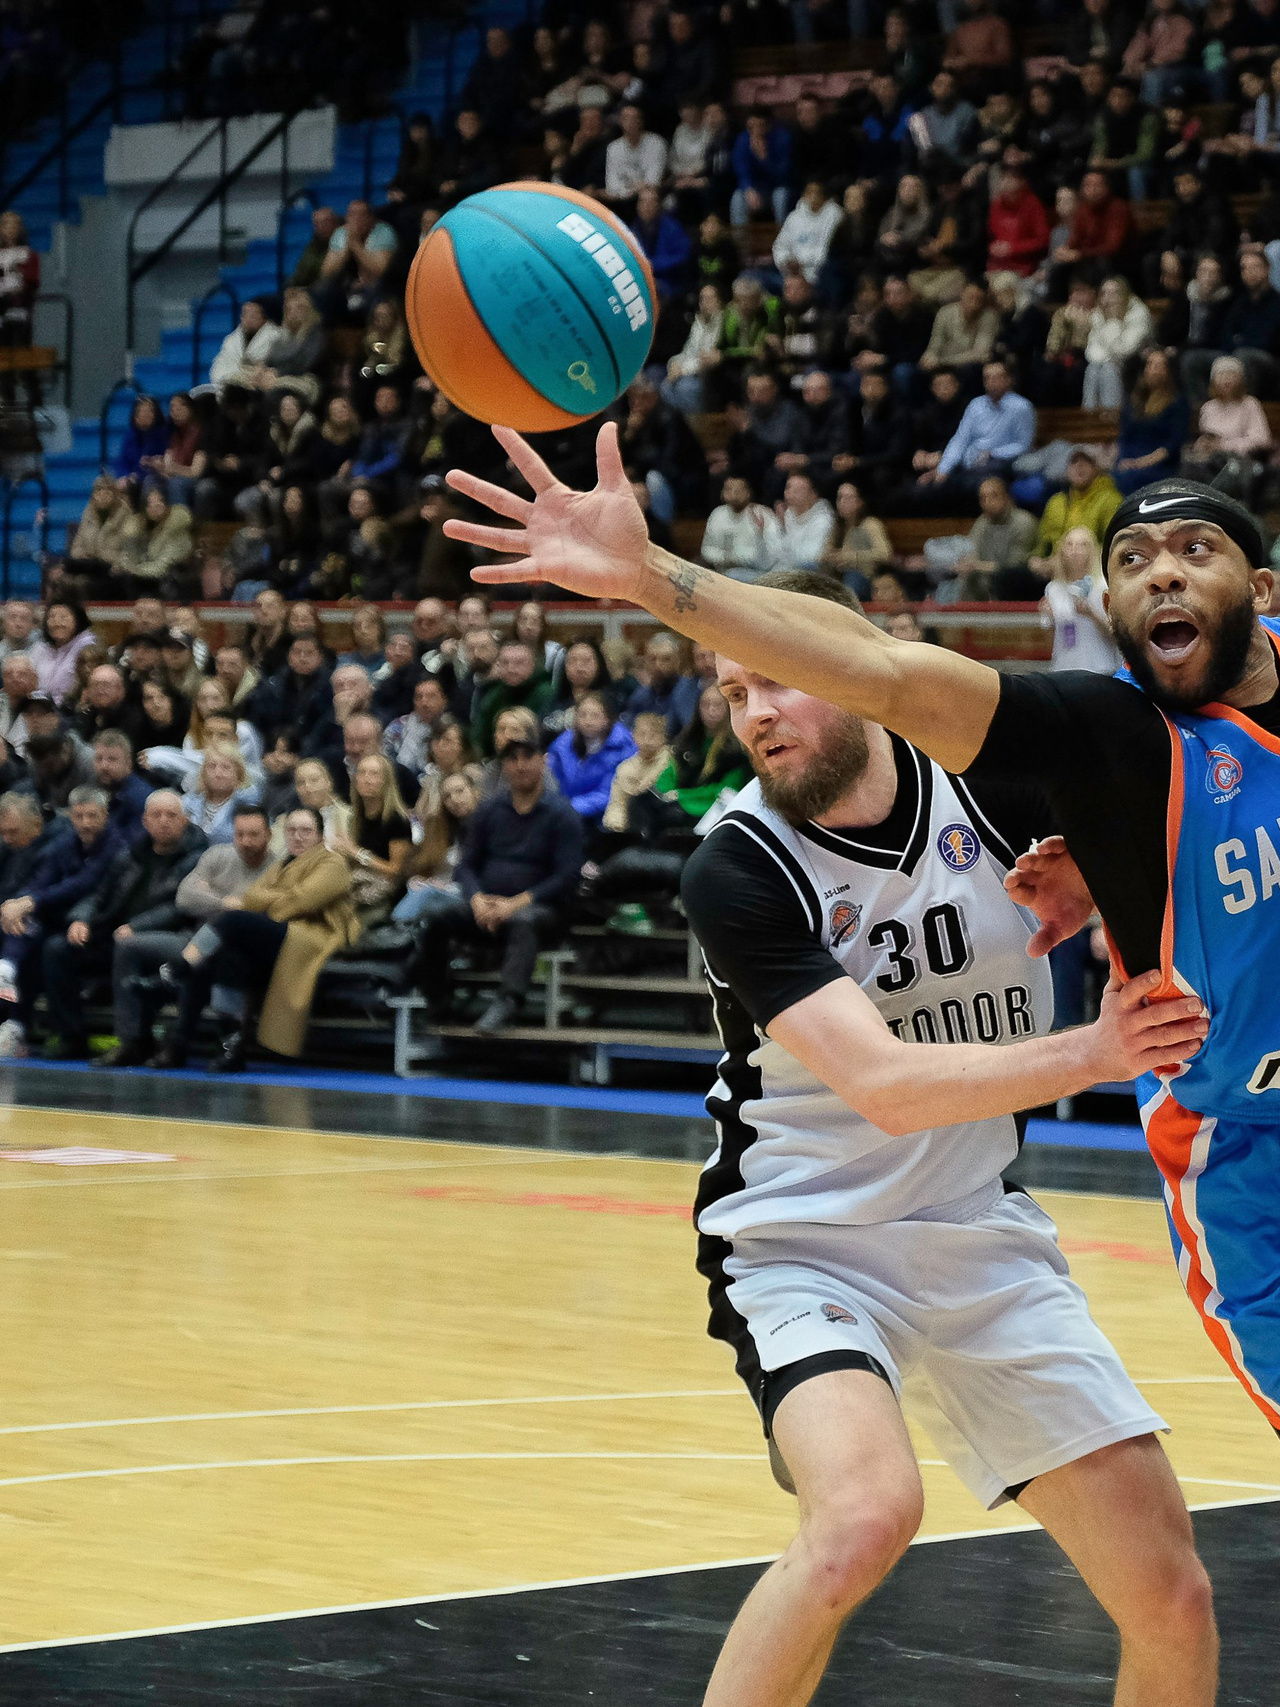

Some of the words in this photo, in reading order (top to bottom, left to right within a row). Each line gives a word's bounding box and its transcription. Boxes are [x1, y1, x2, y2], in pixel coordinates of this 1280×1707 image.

[556, 212, 648, 332] SIBUR
[867, 901, 975, 995] 30
[886, 984, 1036, 1043] TODOR
